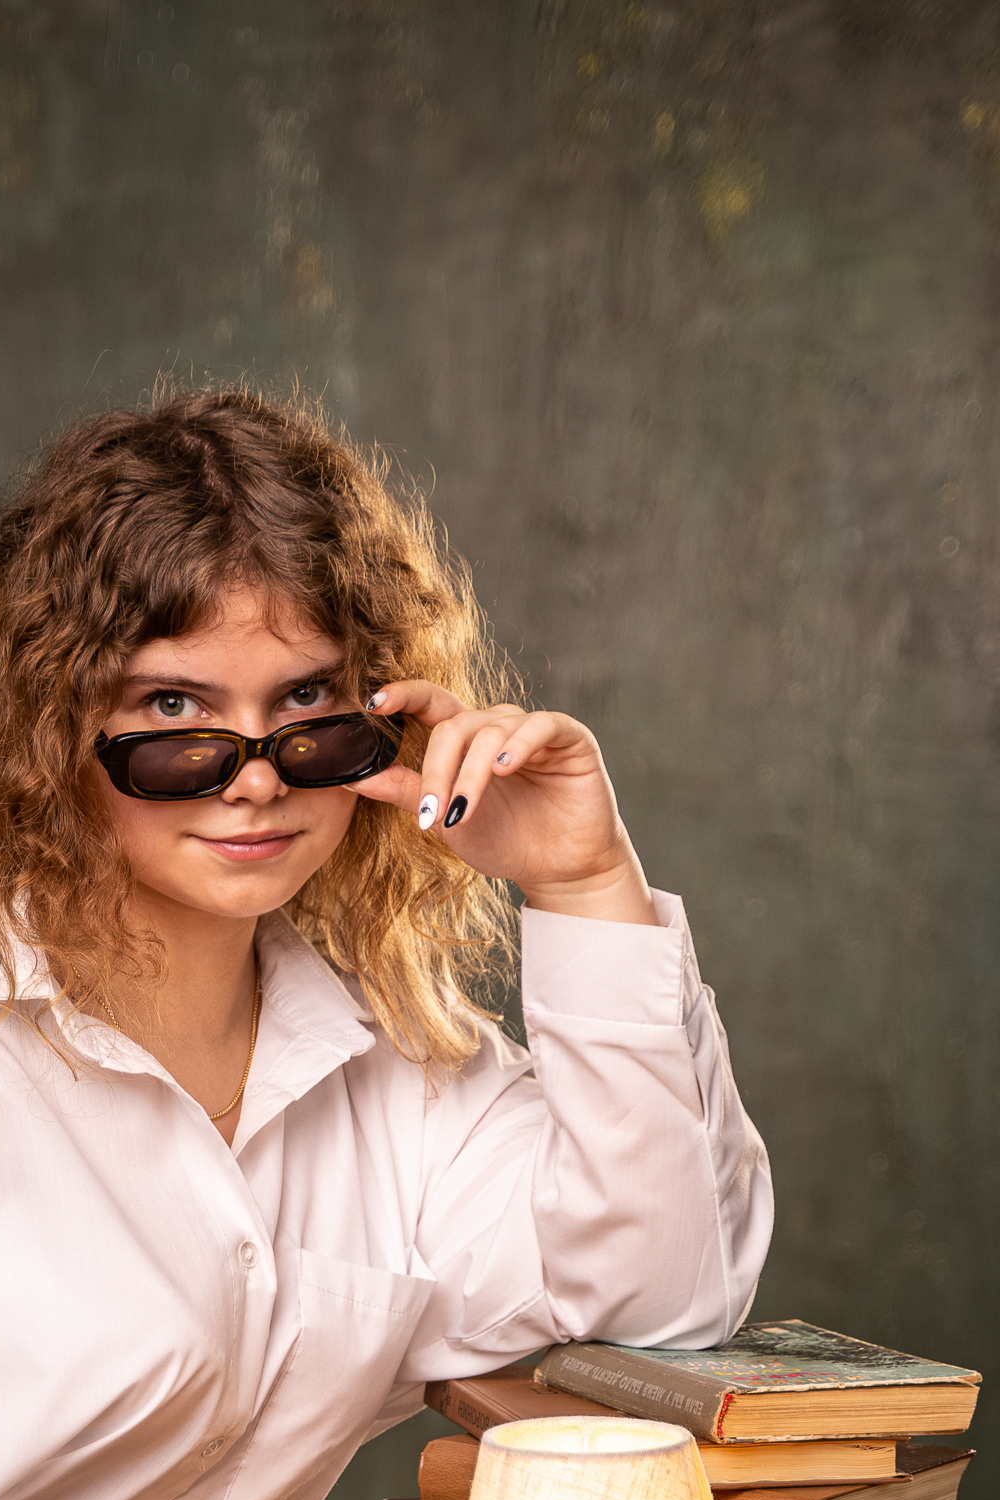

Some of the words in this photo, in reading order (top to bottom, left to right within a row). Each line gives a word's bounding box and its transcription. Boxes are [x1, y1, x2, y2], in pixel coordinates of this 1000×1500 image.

[592, 1365, 624, 1387] ДЕСЯТЬ
[618, 1374, 644, 1394] БЫЛО
[642, 1383, 666, 1402] МЕНЯ
[663, 1390, 673, 1404] У
[672, 1392, 685, 1407] БЫ
[683, 1397, 704, 1416] ЕСЛИ
